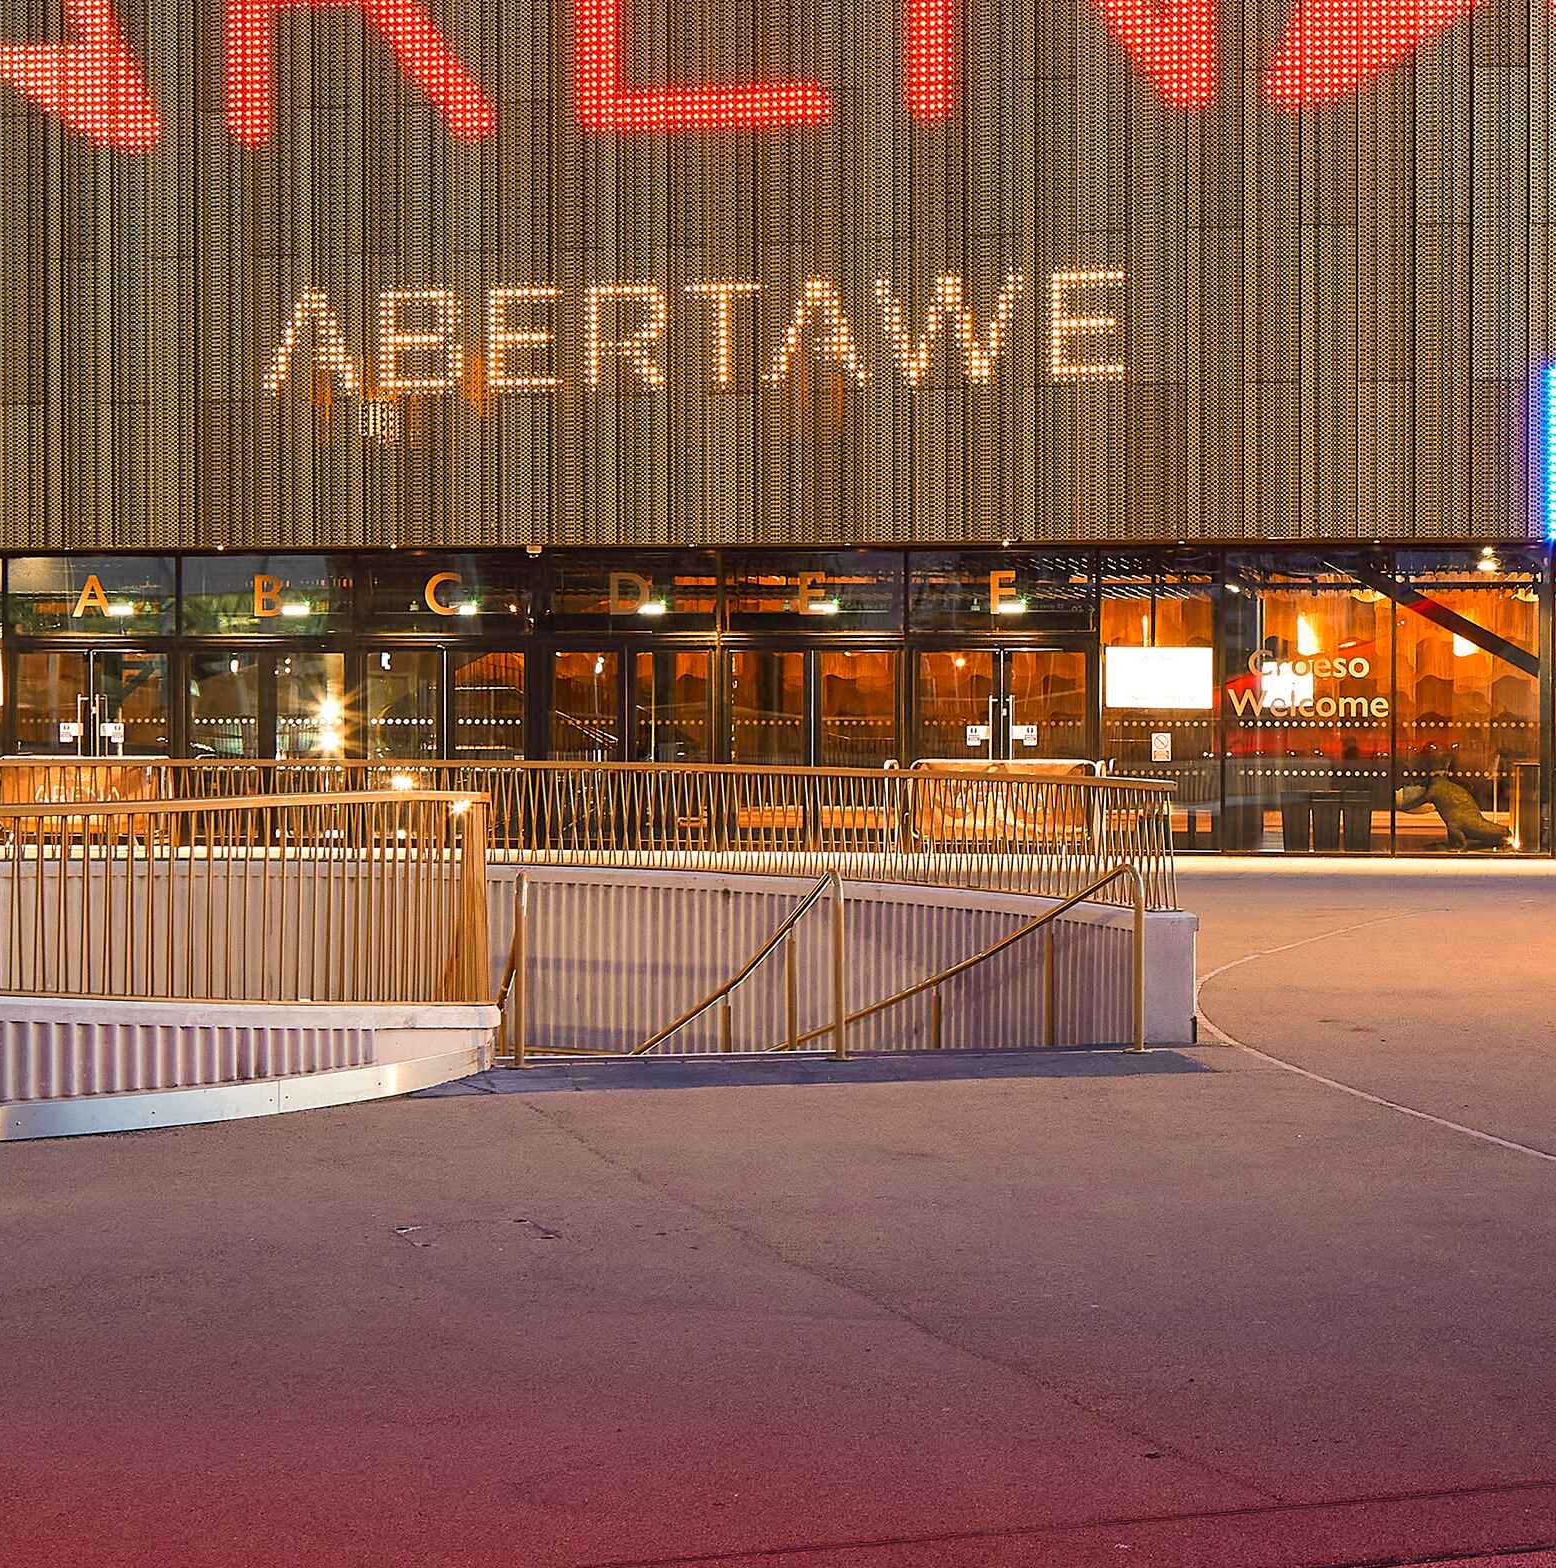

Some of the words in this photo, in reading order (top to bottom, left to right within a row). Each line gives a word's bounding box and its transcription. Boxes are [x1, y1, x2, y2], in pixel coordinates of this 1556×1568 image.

[260, 267, 1129, 393] ABERTAWE
[73, 575, 109, 617] A
[254, 575, 284, 617] B
[425, 572, 462, 616] C
[610, 572, 650, 615] D
[799, 571, 826, 615] E
[991, 570, 1017, 614] F
[1248, 648, 1370, 679] Croeso
[1227, 688, 1389, 718] Welcome
